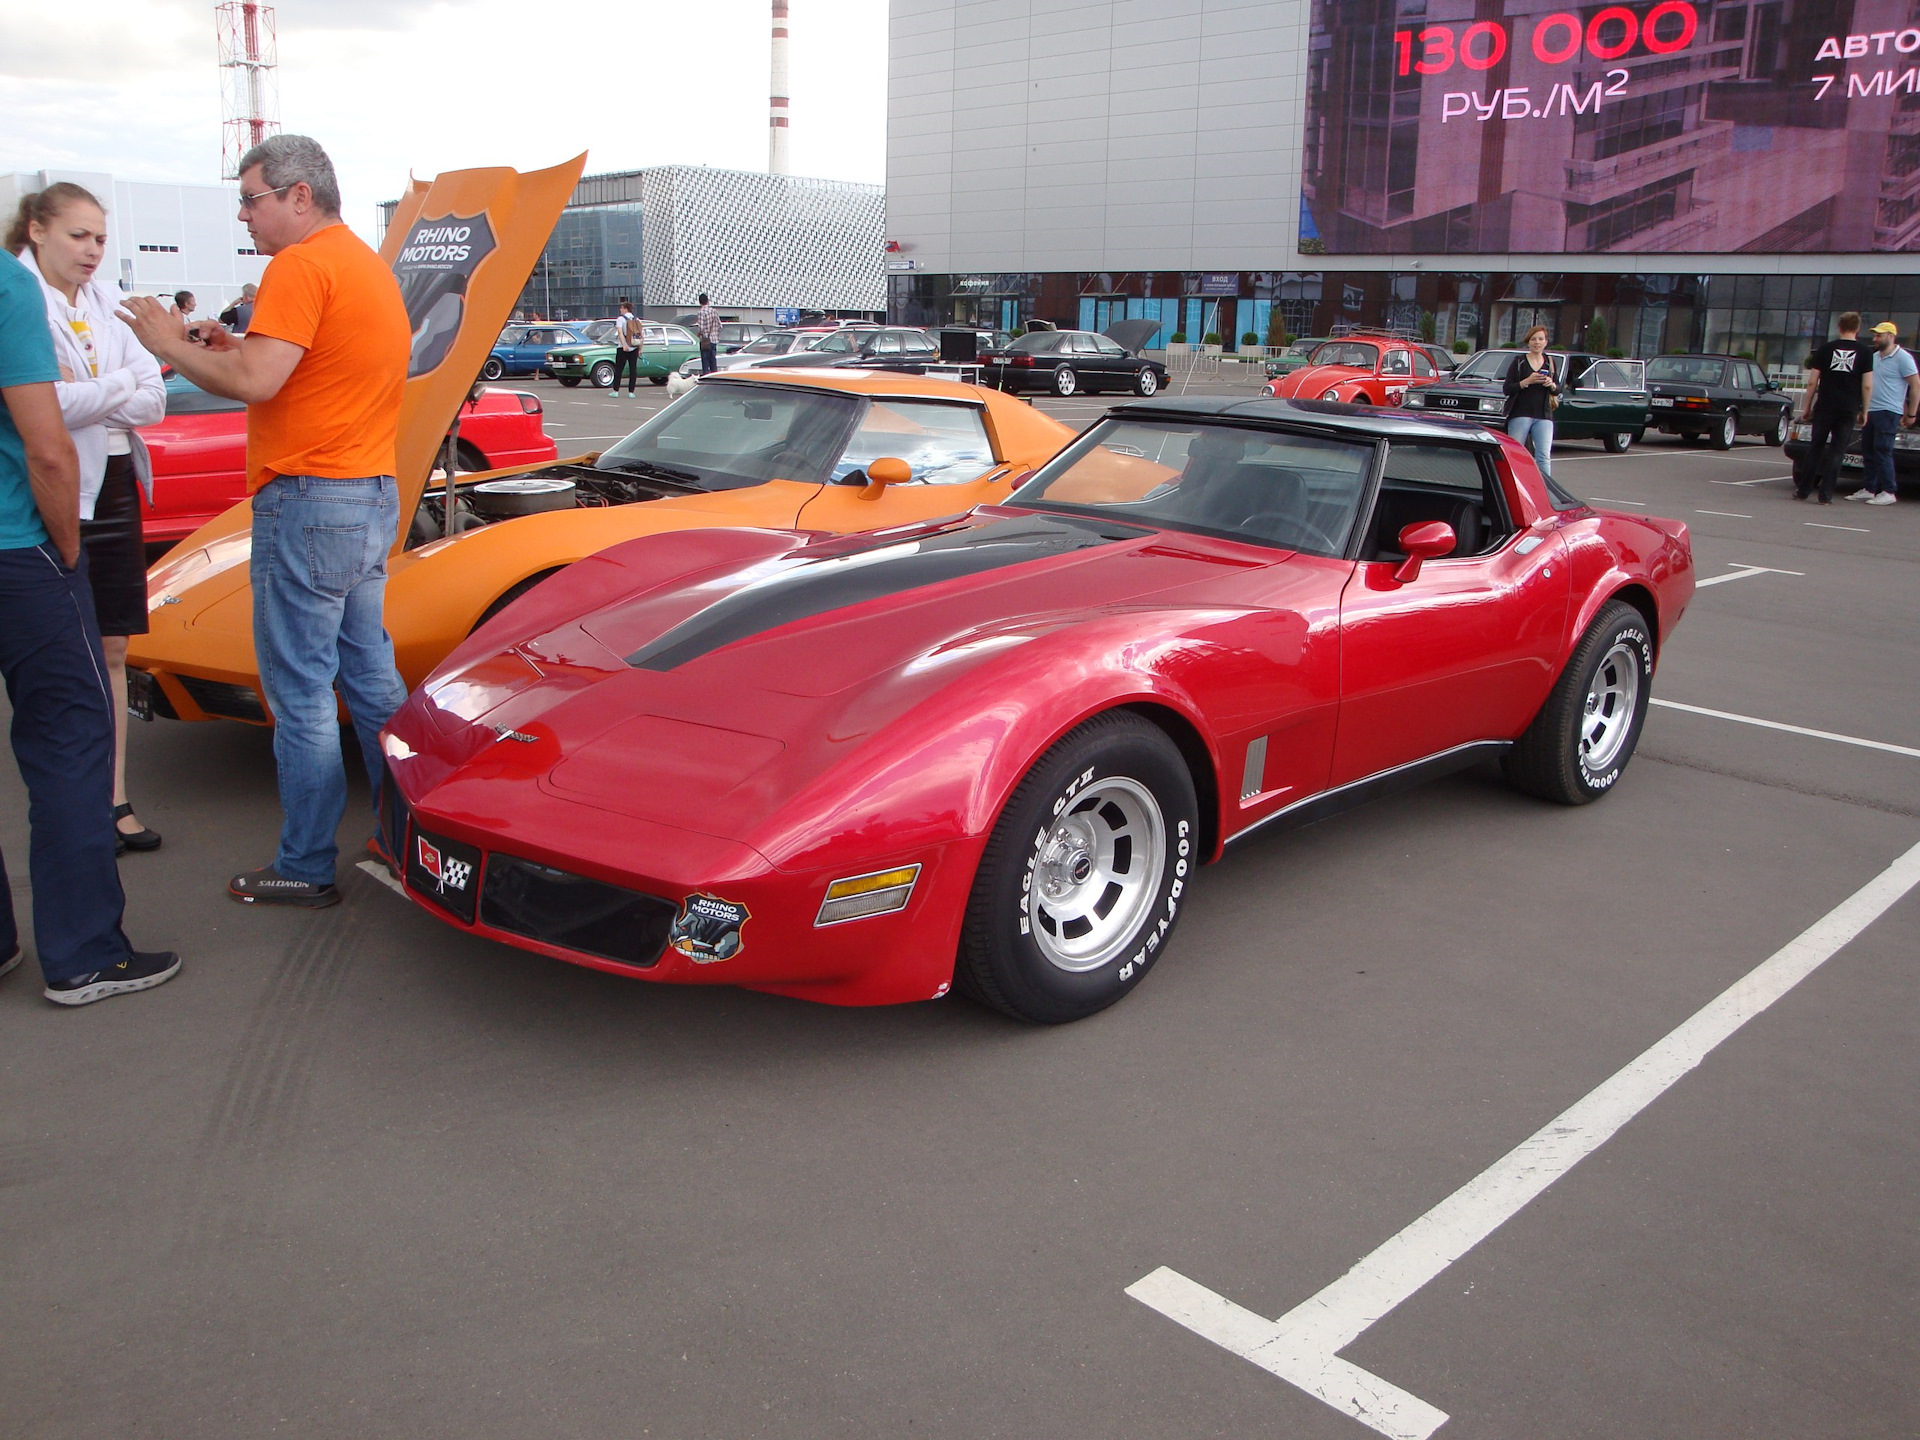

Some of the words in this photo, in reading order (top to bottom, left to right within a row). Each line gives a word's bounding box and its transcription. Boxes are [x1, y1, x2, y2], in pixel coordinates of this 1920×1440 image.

[1394, 21, 1507, 76] 130
[1532, 1, 1698, 64] 000
[1811, 75, 1835, 101] 7
[414, 226, 471, 244] RHINO
[399, 245, 471, 263] MOTORS
[1614, 628, 1644, 646] EAGLE
[257, 880, 310, 888] SALOMON
[1019, 826, 1047, 936] EAGLE
[698, 899, 737, 913] RHINO
[1118, 820, 1191, 982] GOODYEAR
[691, 904, 740, 922] MOTORS
